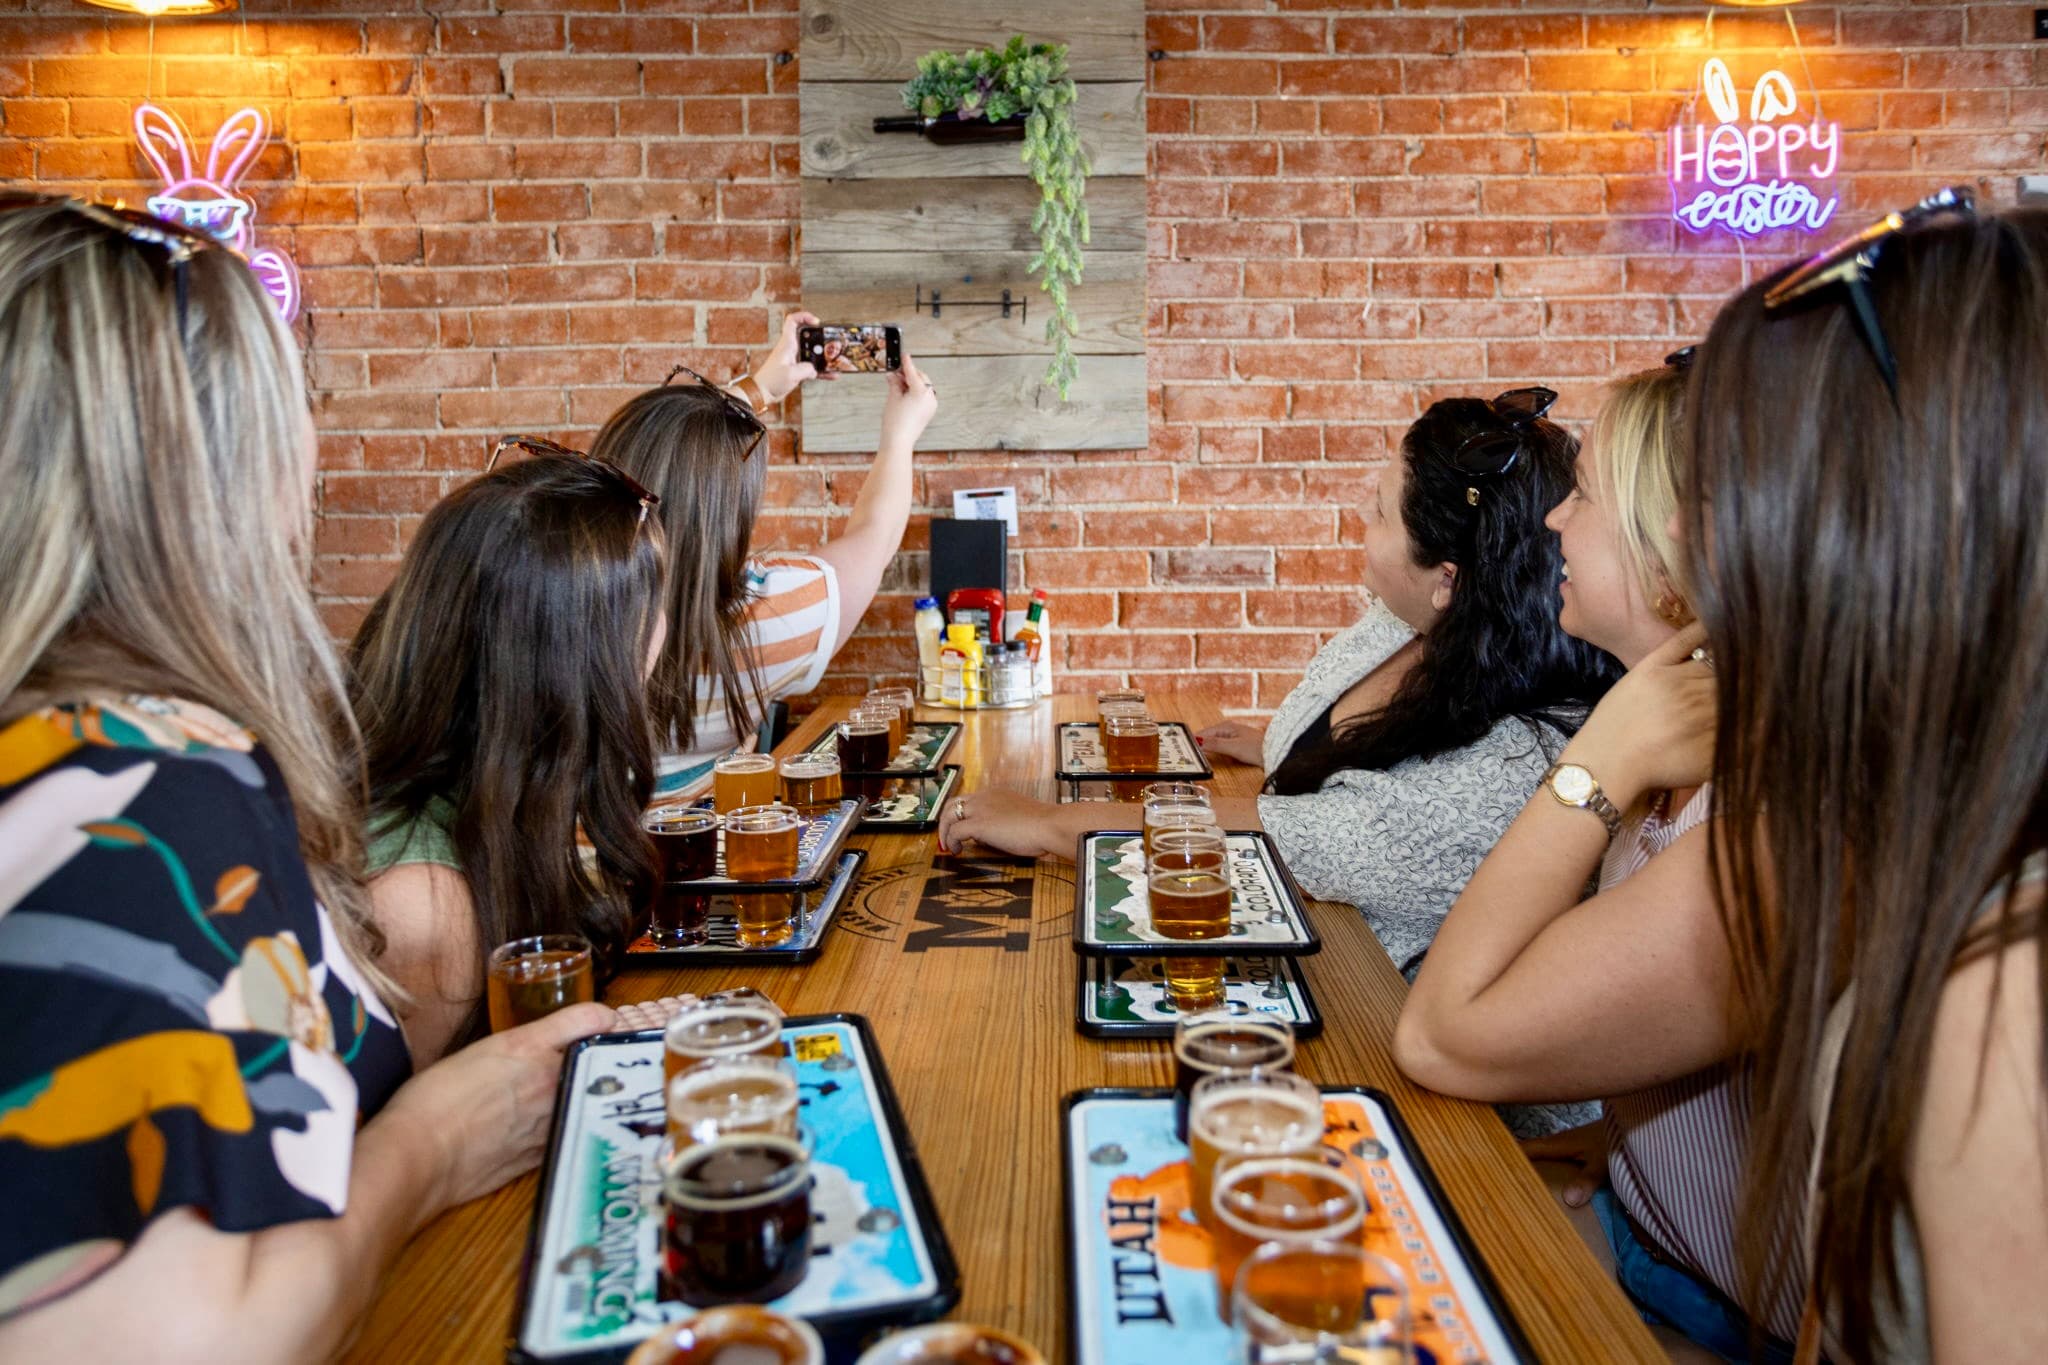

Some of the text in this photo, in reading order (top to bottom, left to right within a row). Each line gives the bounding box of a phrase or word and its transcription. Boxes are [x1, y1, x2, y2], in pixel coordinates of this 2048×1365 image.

[1678, 180, 1838, 234] easter
[1233, 860, 1274, 912] COLORADO
[592, 1153, 642, 1318] WYOMING
[1106, 1195, 1174, 1325] UTAH
[1368, 1162, 1443, 1284] ELEVATED
